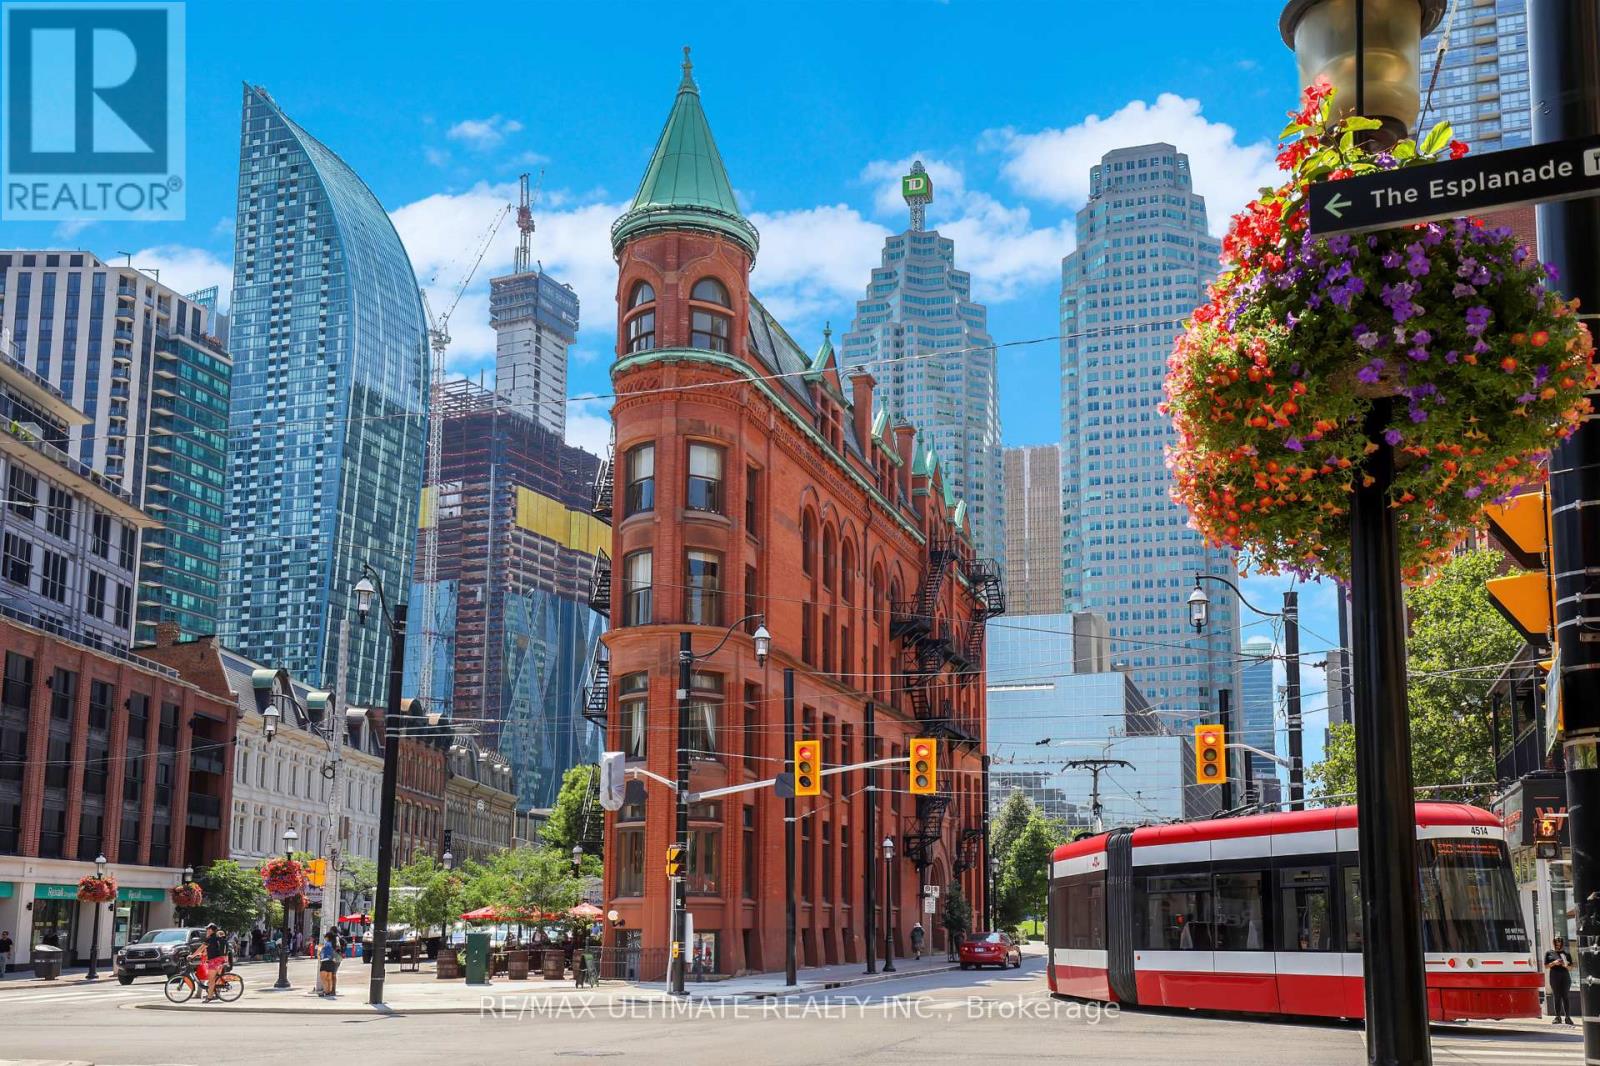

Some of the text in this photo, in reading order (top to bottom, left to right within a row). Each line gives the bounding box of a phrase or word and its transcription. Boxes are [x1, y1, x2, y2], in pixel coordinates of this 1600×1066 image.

[905, 177, 924, 191] TD
[1370, 160, 1573, 209] The Esplanade
[1470, 826, 1488, 836] 4514
